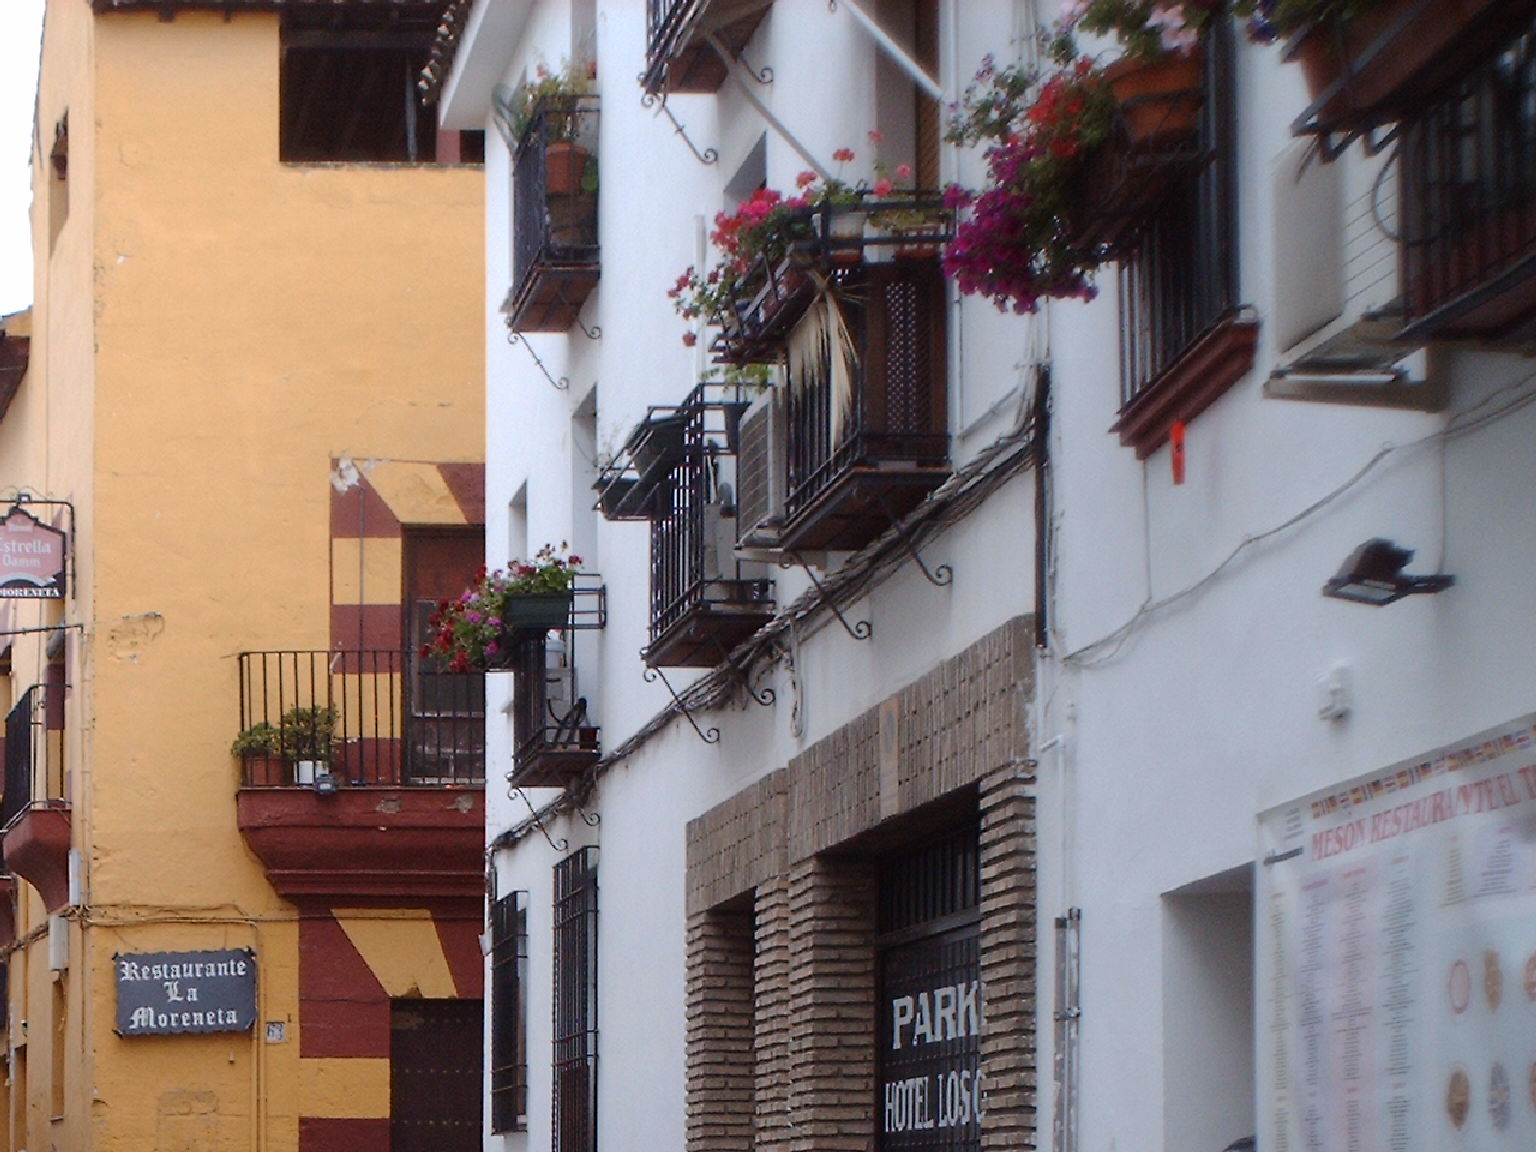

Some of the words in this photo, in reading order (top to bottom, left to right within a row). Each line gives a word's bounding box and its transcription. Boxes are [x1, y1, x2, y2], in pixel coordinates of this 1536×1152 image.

[119, 958, 247, 982] Restaurante
[162, 981, 199, 1003] La
[129, 1006, 238, 1030] Moreneta
[885, 1076, 934, 1132] HOTEL
[937, 1069, 971, 1128] LOS
